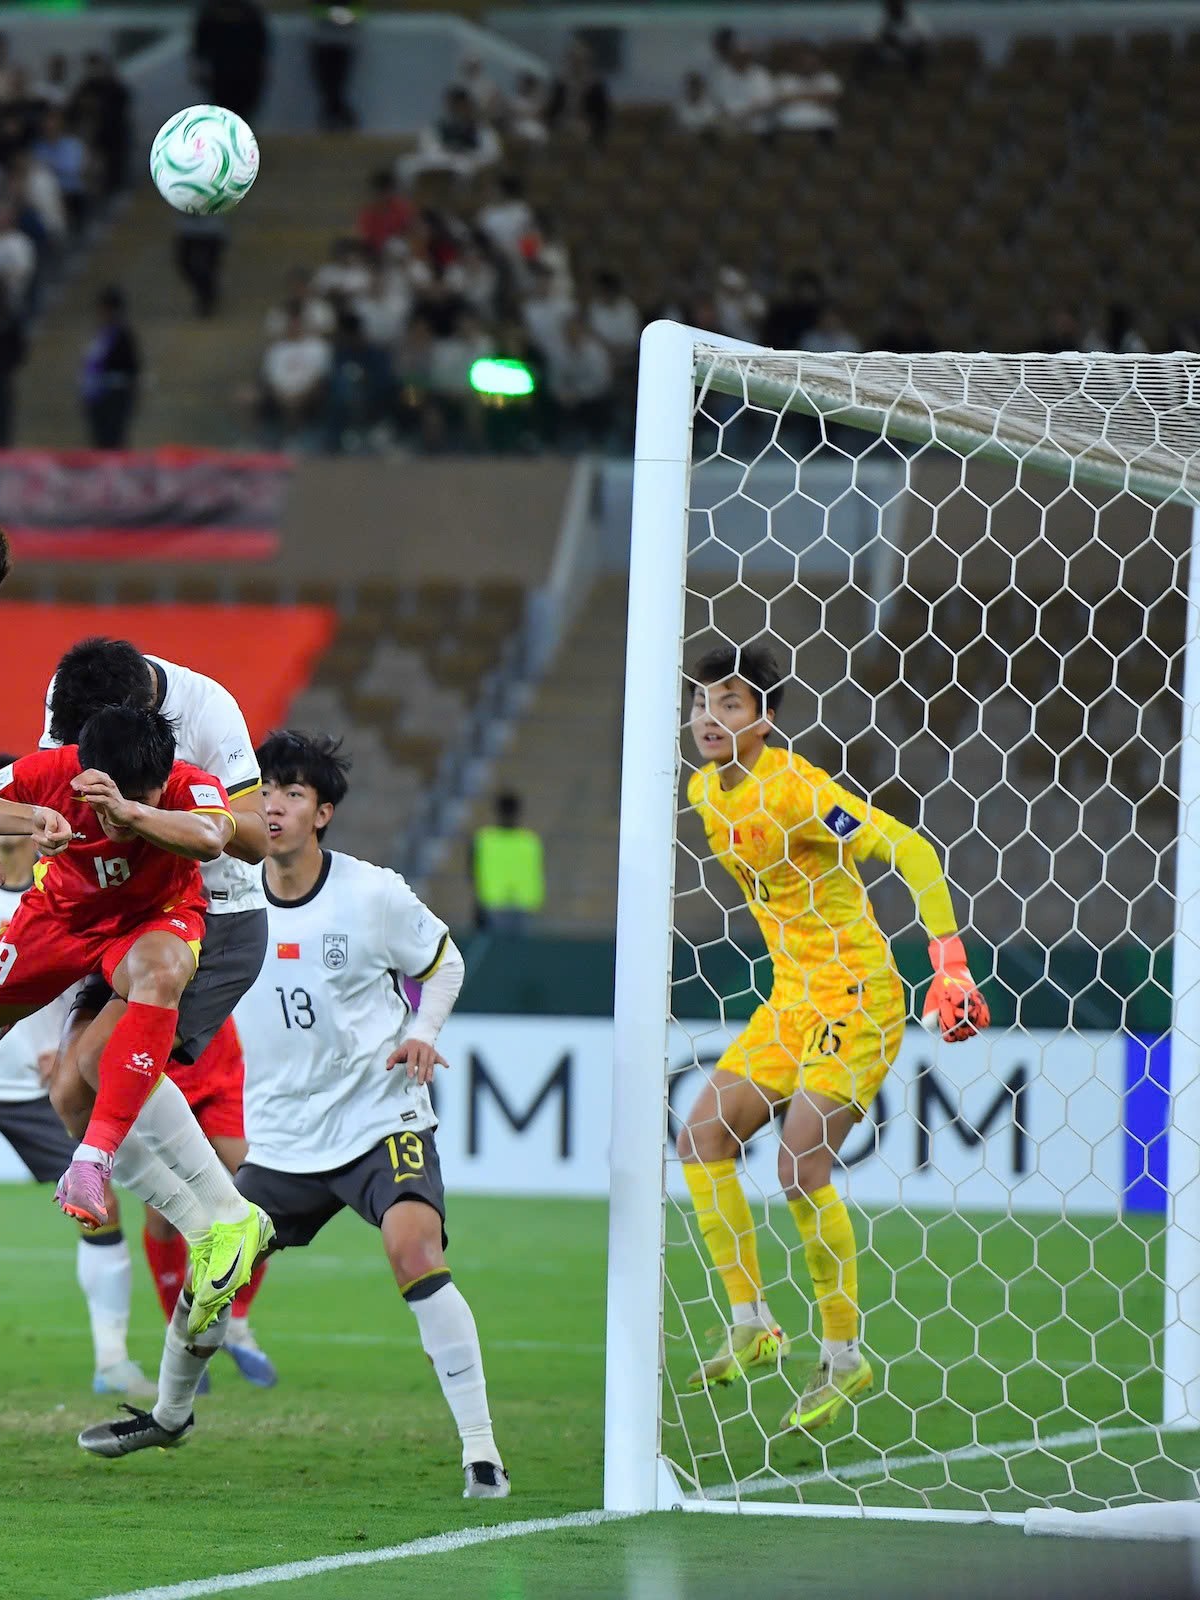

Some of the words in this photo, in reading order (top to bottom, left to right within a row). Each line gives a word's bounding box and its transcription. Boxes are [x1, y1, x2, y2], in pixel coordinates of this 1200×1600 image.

[228, 749, 245, 763] AFC
[94, 856, 131, 889] 19
[275, 987, 316, 1030] 13
[808, 1021, 847, 1056] 16
[384, 1131, 424, 1170] 13
